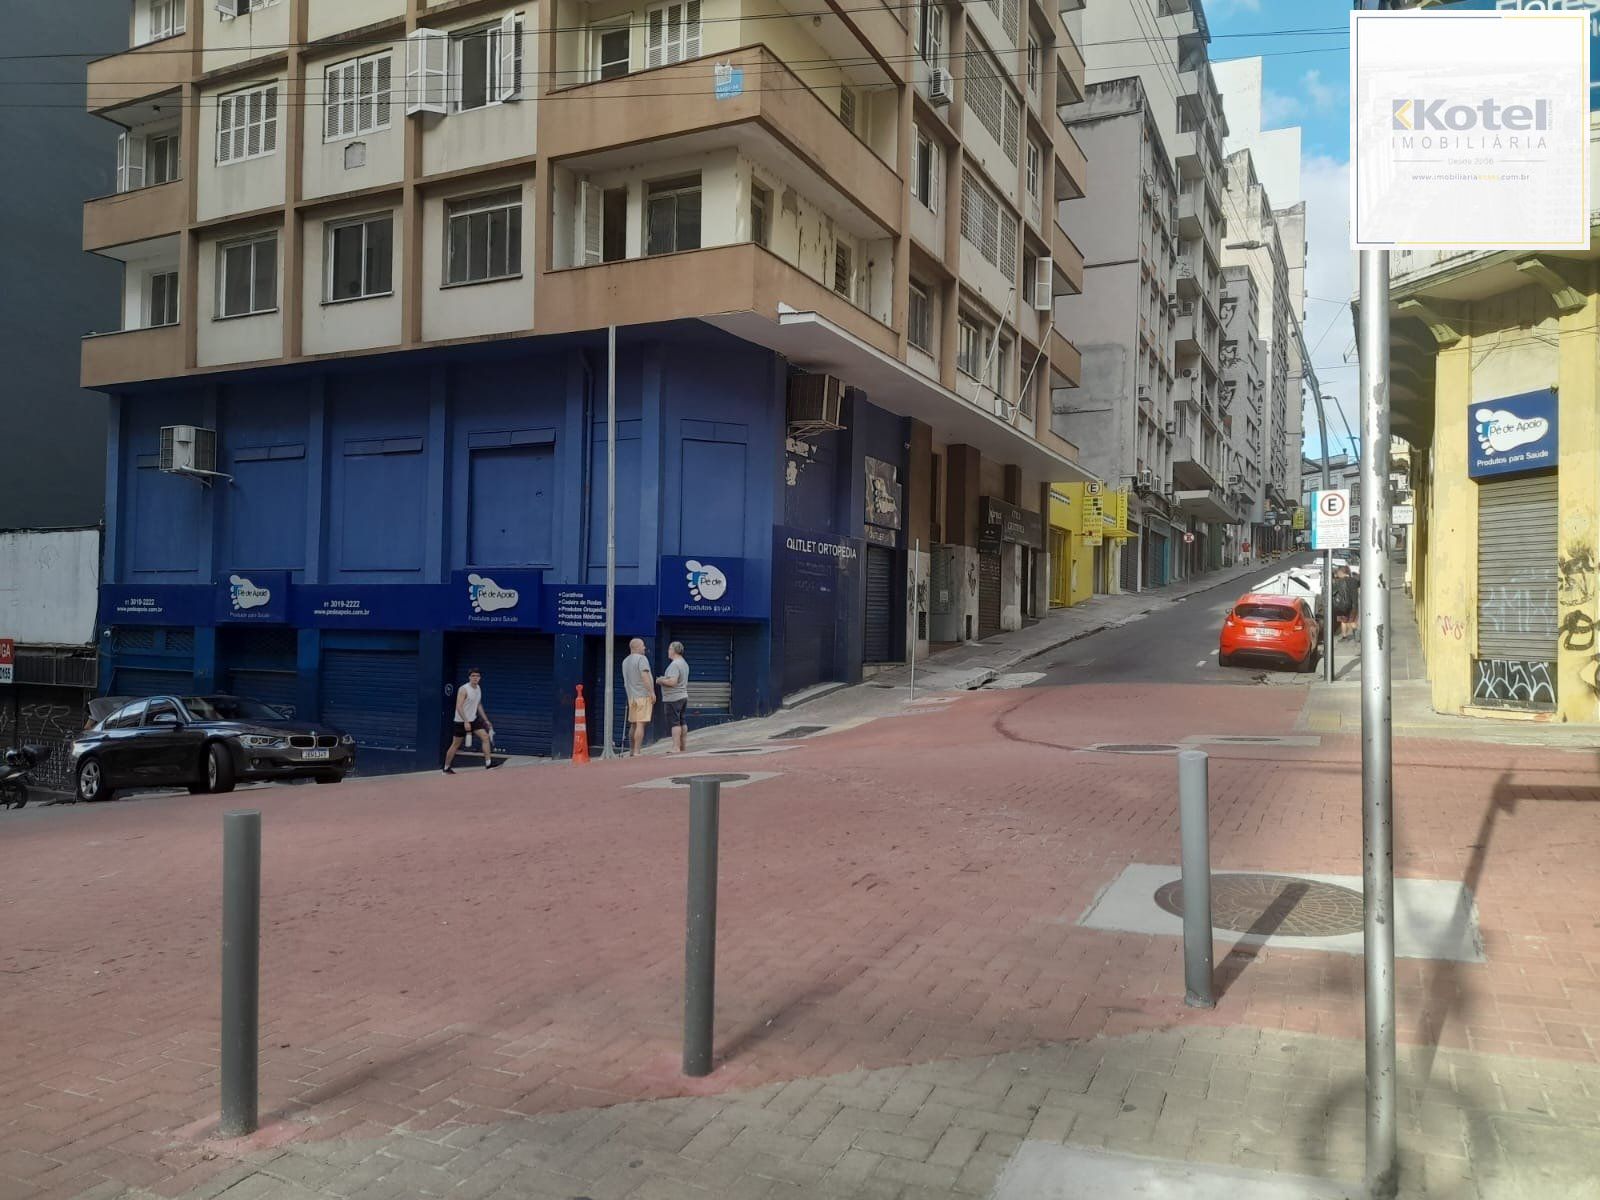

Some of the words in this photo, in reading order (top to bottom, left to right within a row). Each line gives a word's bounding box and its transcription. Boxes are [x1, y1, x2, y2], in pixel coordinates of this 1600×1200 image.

[1477, 457, 1507, 467] Produtos
[1508, 454, 1525, 464] para
[1328, 498, 1337, 511] E
